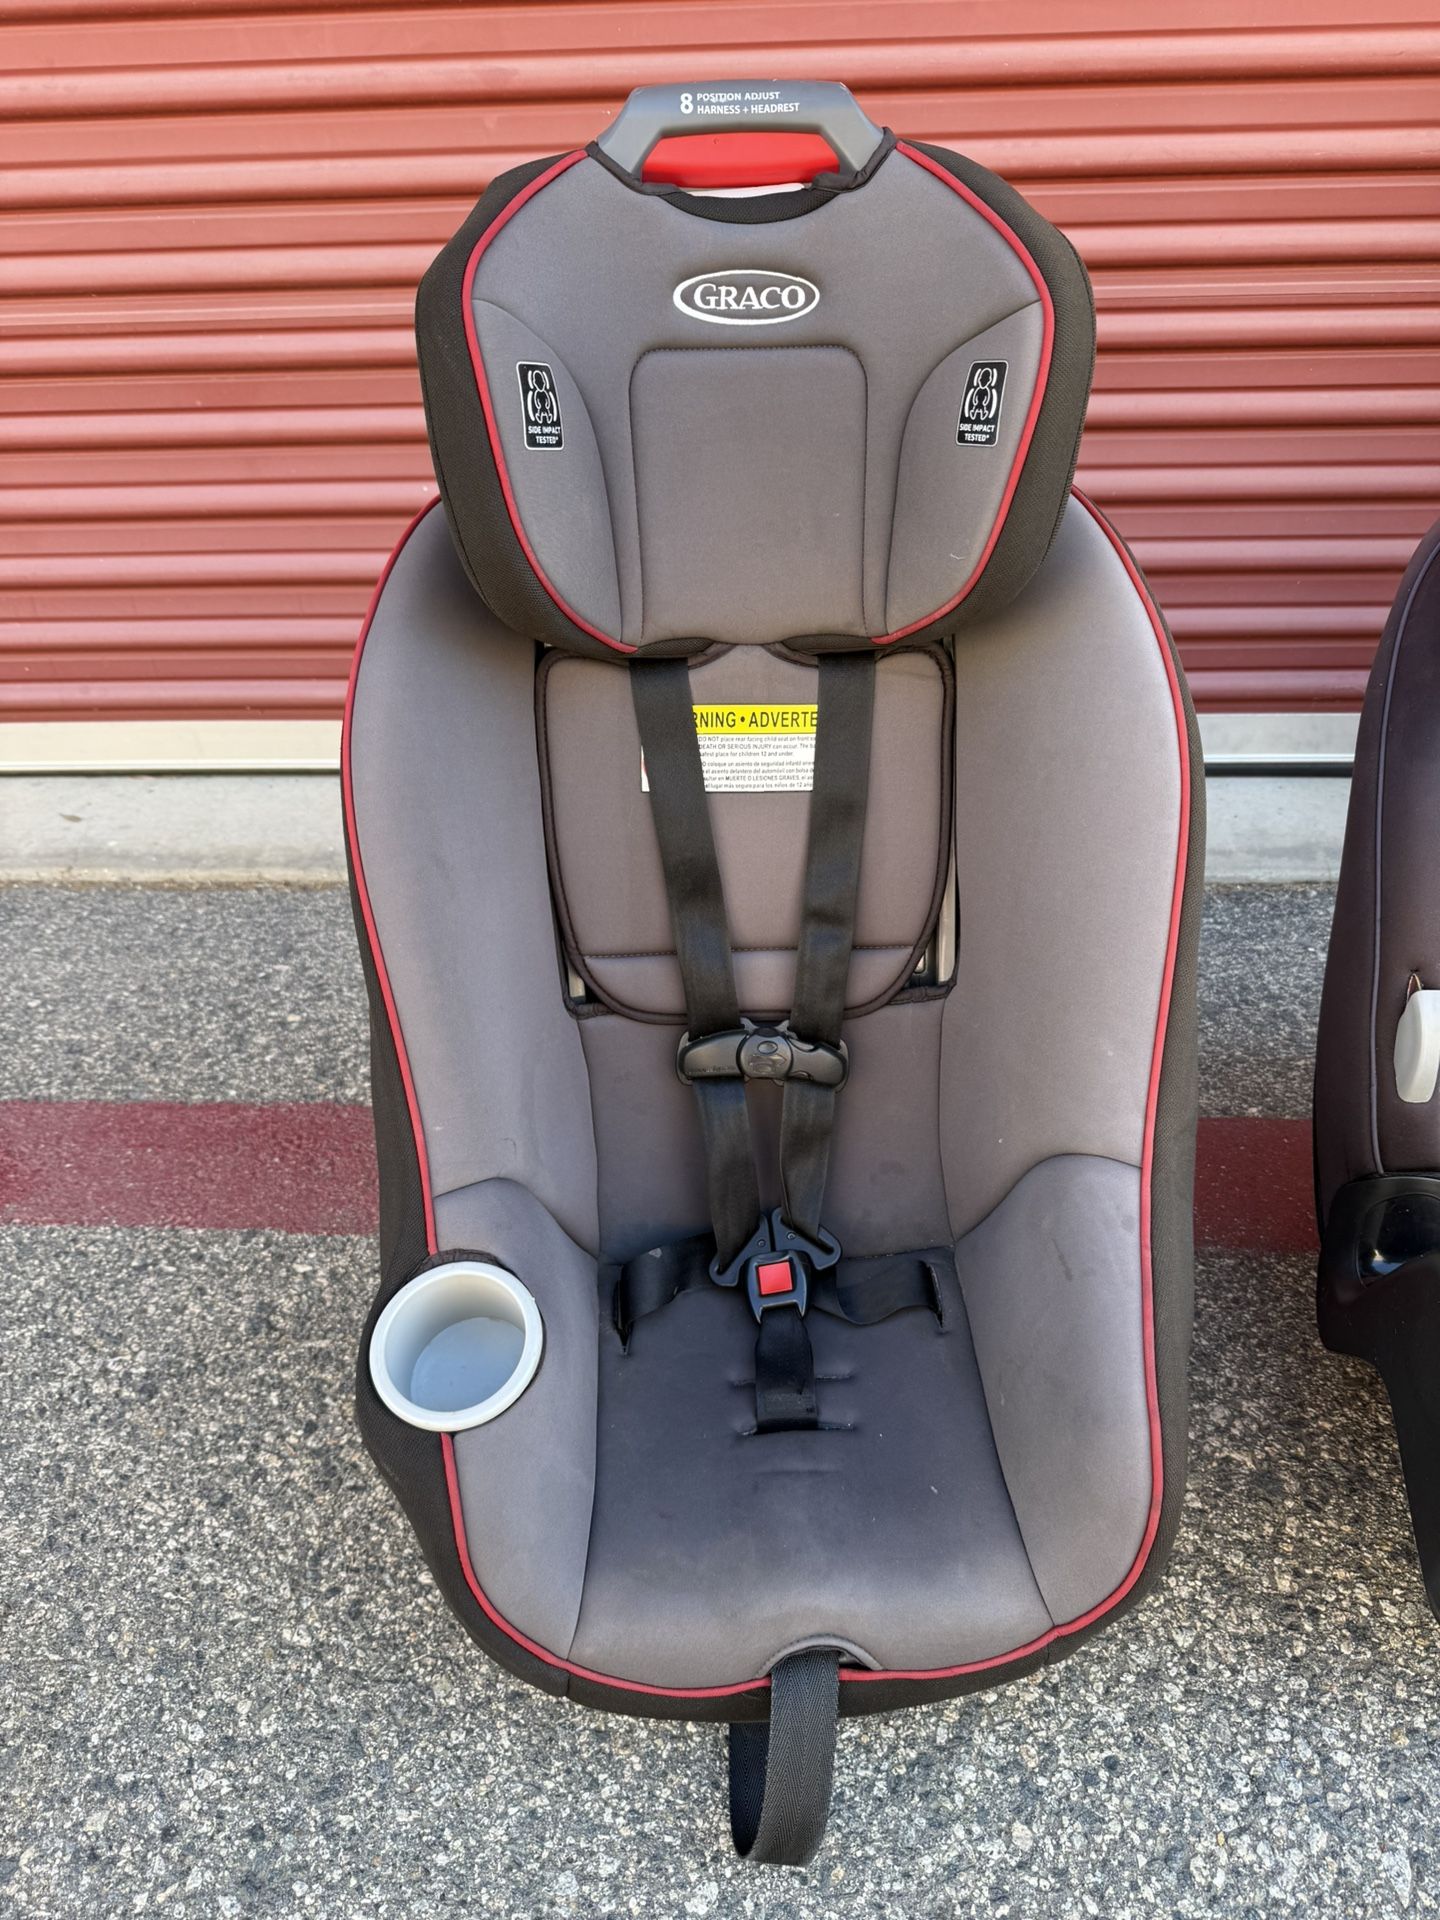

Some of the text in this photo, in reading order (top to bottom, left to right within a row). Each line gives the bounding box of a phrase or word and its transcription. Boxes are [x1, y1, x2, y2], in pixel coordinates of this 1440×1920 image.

[697, 91, 780, 102] POSITION ADJUST
[680, 93, 694, 114] 8
[697, 105, 741, 114] HARNESS
[751, 102, 800, 113] HEADREST
[693, 283, 806, 310] GRACO
[528, 425, 561, 434] SIDE IMPACT
[959, 423, 995, 432] SIDE IMPACT
[760, 760, 785, 768] seguridad
